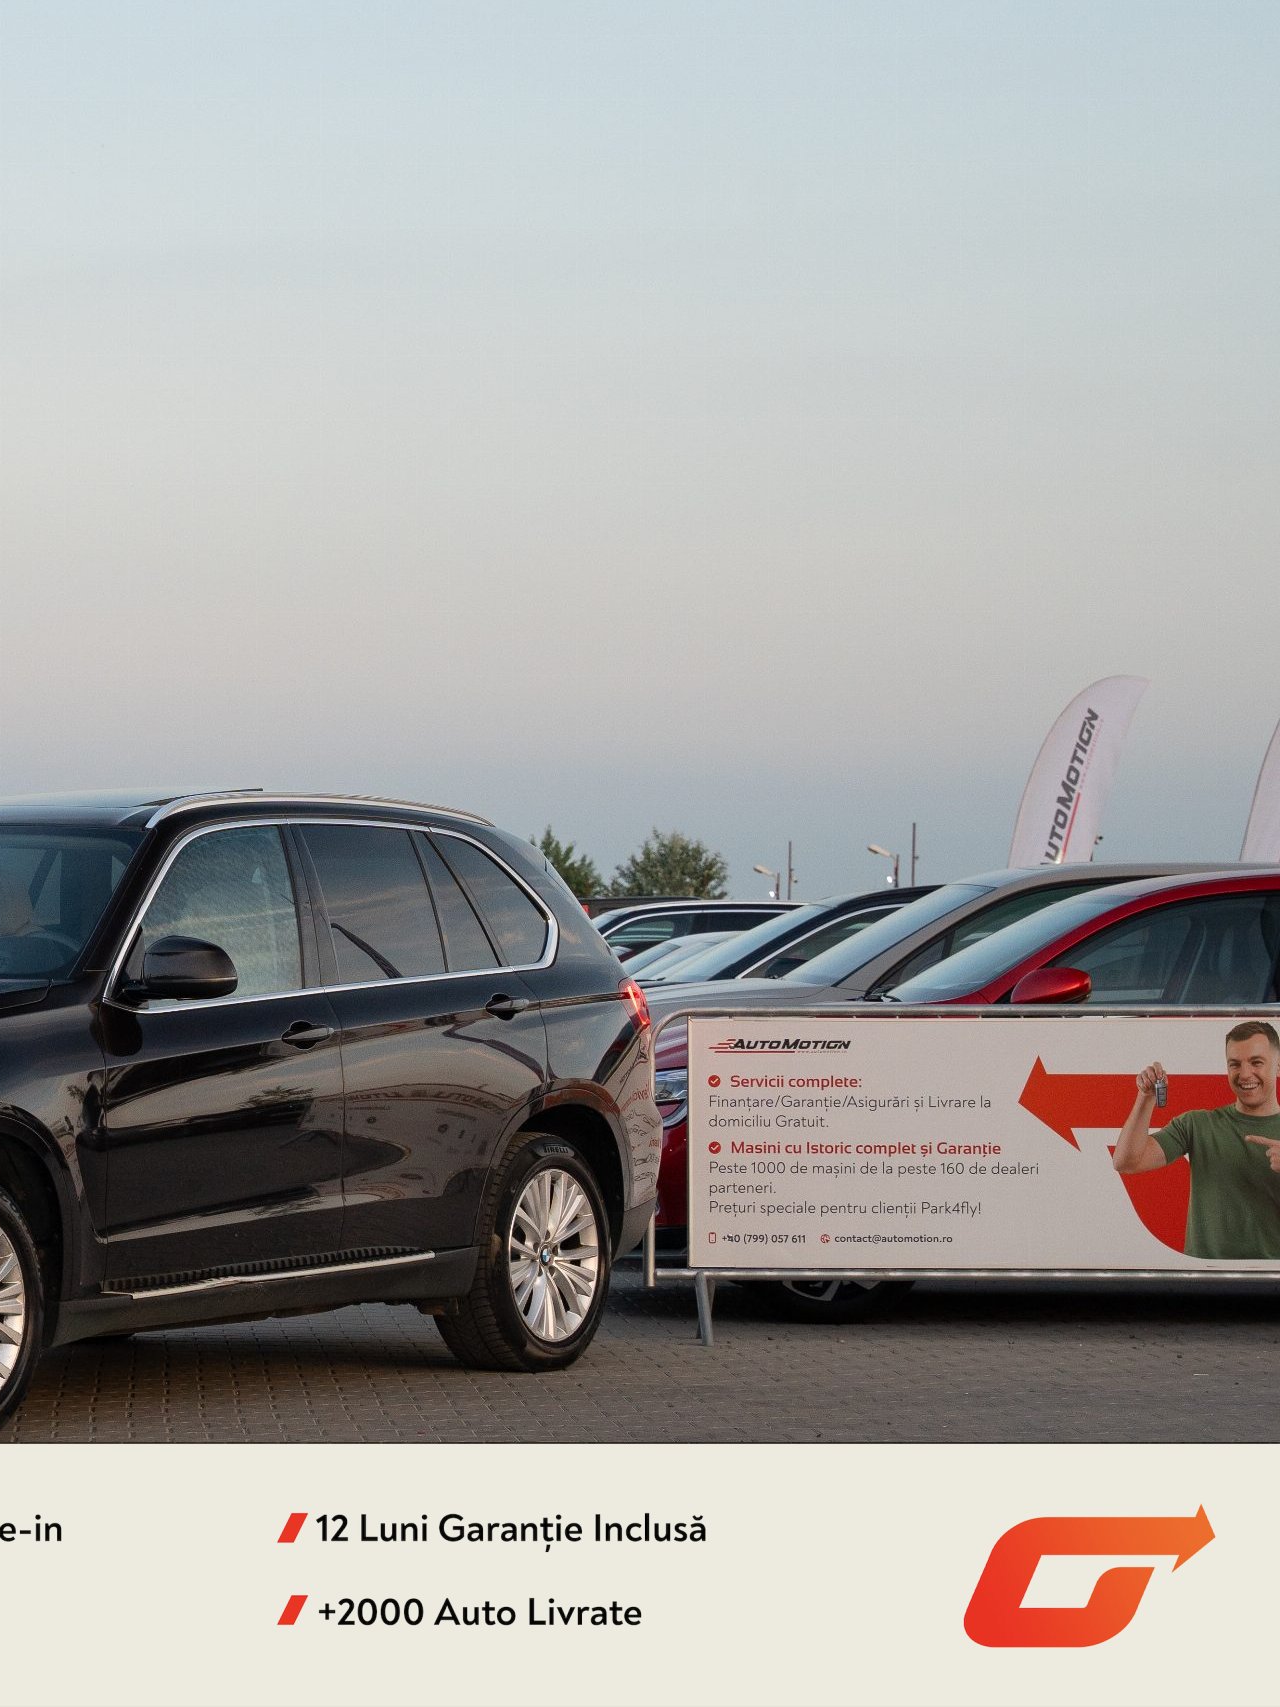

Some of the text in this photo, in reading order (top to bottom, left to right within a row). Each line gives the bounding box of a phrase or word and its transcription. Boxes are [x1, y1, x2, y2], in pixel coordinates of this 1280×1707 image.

[731, 1075, 861, 1090] Servicii complete:
[710, 1095, 991, 1112] Finanțare/Garanție/Asigurări și Livrare la
[709, 1114, 828, 1127] domiciliu Gratuit.
[732, 1141, 1001, 1157] Masini cu Istoric complet și Garanție
[710, 1161, 1038, 1178] Peste 1000 de mașini de la peste 160 de dealeri
[710, 1182, 776, 1196] parteneri.
[710, 1201, 980, 1218] Prețuri speciale pentru clienții Park4fly!
[744, 1234, 768, 1244] (799)
[771, 1235, 788, 1243] 057
[792, 1235, 805, 1243] 611
[834, 1234, 952, 1244] contact@automotion.ro
